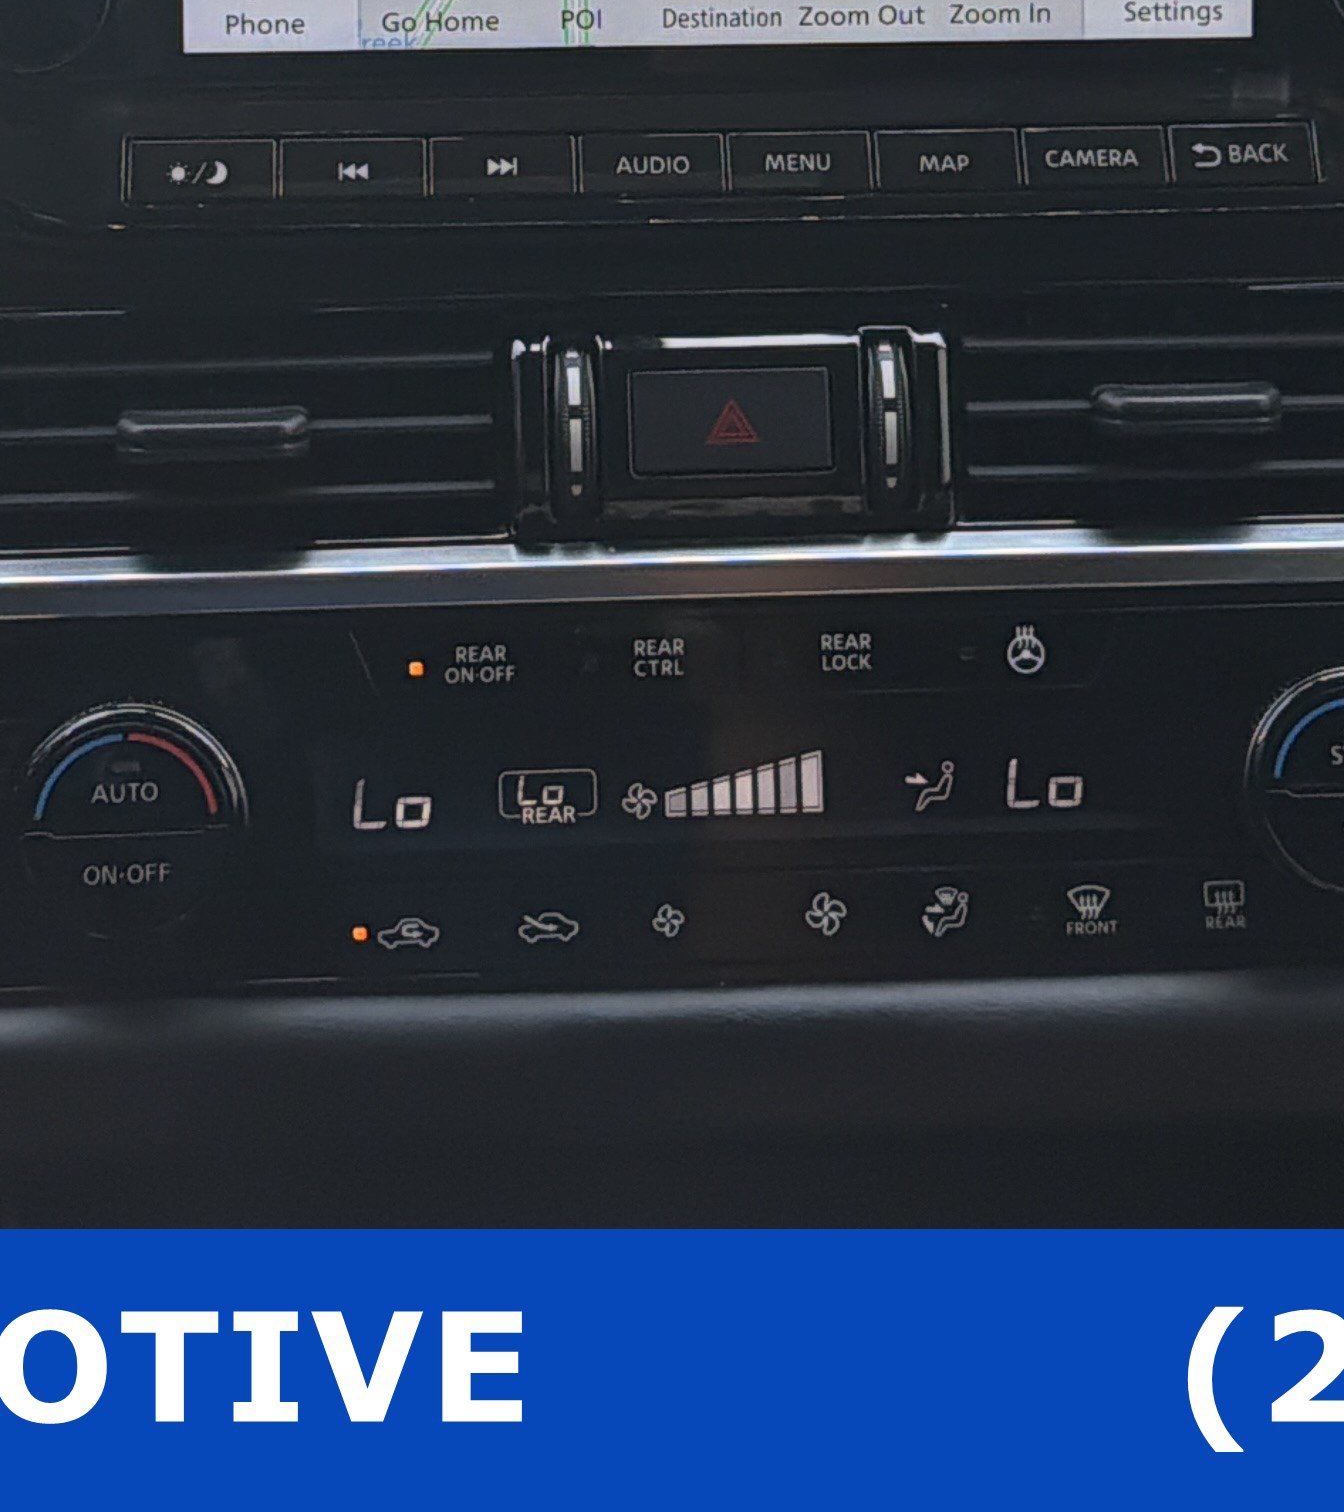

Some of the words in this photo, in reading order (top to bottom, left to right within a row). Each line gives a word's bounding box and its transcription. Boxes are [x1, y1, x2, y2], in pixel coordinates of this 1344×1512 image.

[382, 12, 417, 32] Go
[425, 12, 500, 32] Home
[561, 9, 603, 30] POI
[662, 6, 782, 30] Destination
[798, 6, 870, 27] Zoom
[878, 4, 926, 26] Out
[949, 4, 1015, 24] Zoom
[1022, 3, 1052, 24] In
[1123, 0, 1224, 25] Settings
[225, 14, 306, 36] Phone
[764, 152, 832, 173] MENU
[1044, 148, 1139, 168] CAMERA
[1227, 141, 1290, 164] BACK
[615, 155, 691, 176] AUDIO
[919, 154, 970, 174] MAP
[633, 637, 685, 657] REAR
[820, 632, 872, 652] REAR
[455, 644, 508, 663] REAR
[820, 654, 873, 672] LOCK
[633, 659, 685, 678] CTRL
[91, 782, 159, 805] AUTO
[517, 775, 564, 806] Lo
[1007, 758, 1084, 808] Lo
[353, 778, 433, 830] Lo
[522, 805, 576, 825] REAR
[1066, 920, 1118, 935] FRONT
[1205, 915, 1246, 929] REAR
